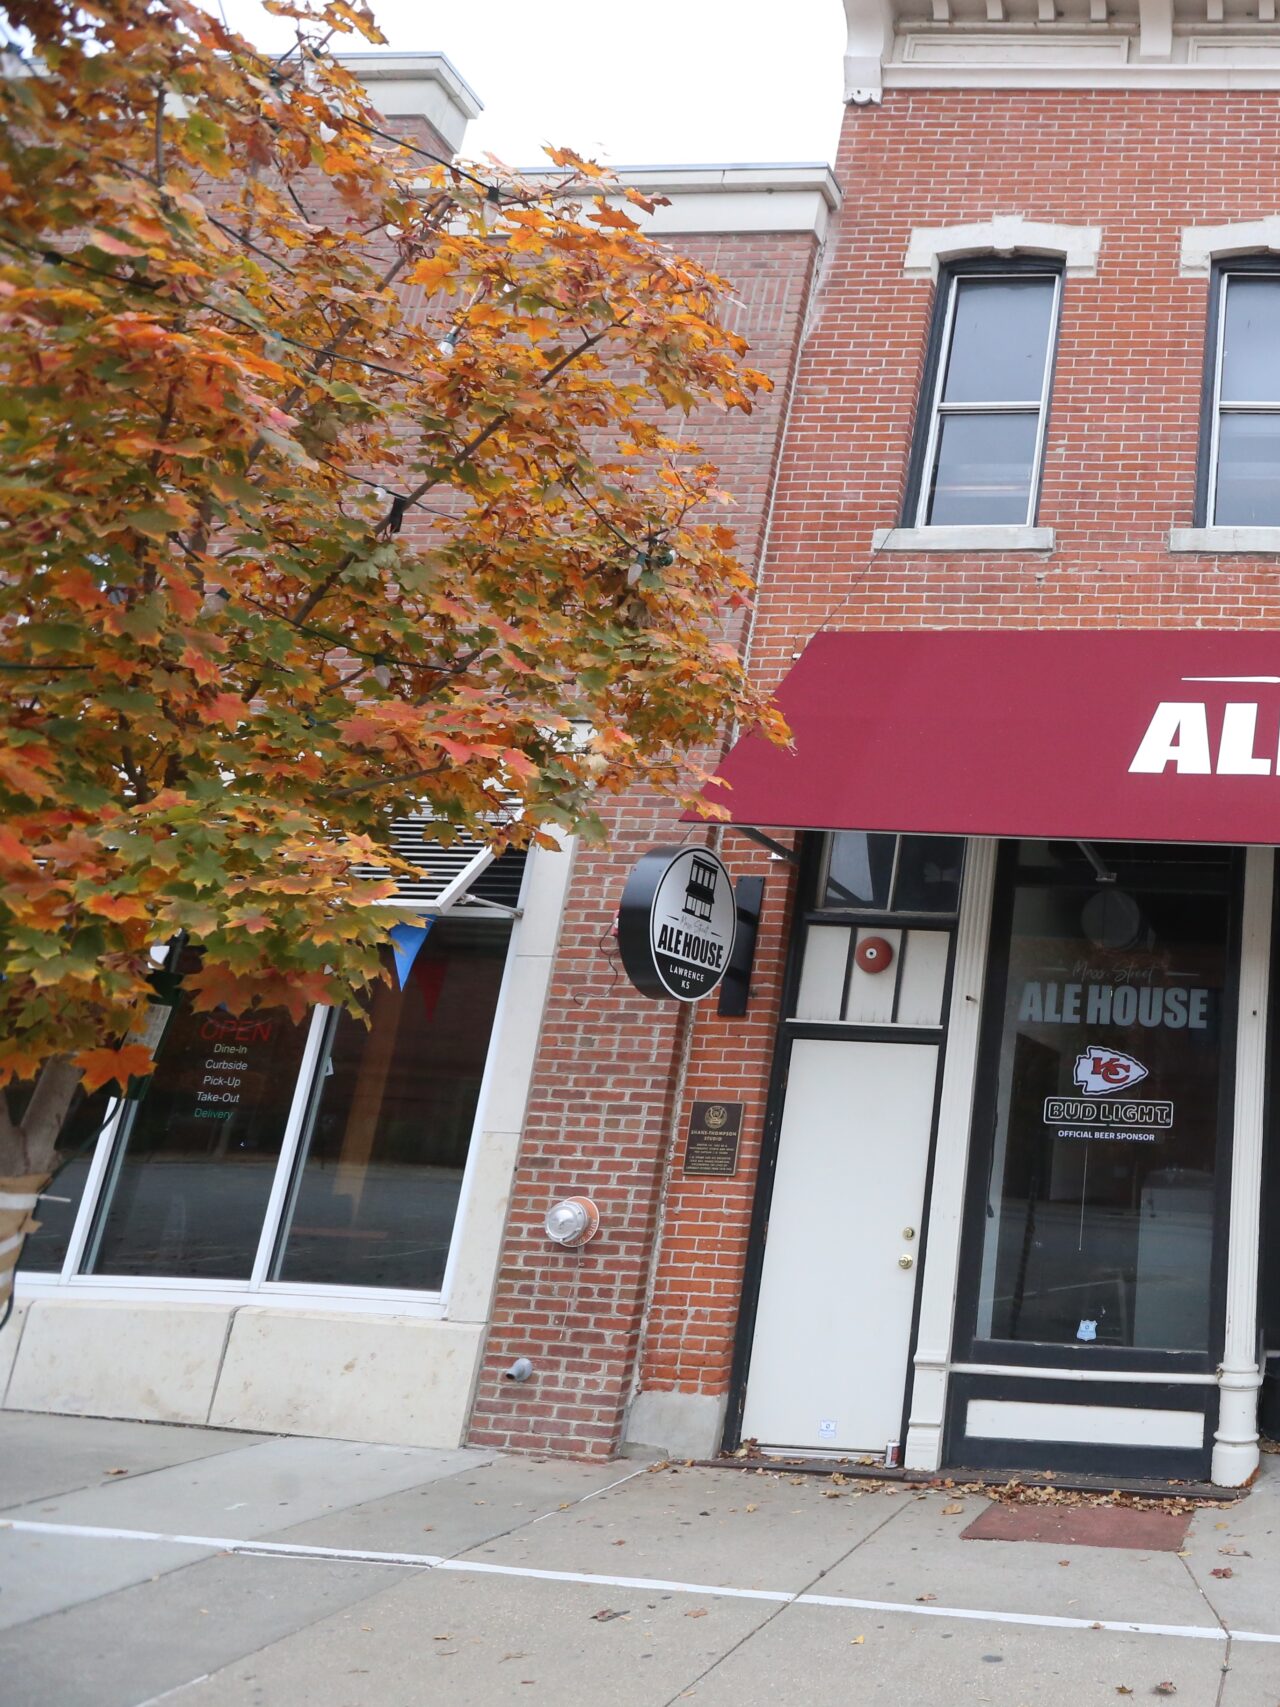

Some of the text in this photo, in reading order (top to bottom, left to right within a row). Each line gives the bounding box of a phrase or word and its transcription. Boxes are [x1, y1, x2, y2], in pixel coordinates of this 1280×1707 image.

[669, 964, 705, 983] LAWRENCE
[681, 980, 690, 990] KS
[198, 1019, 273, 1041] OPEN
[213, 1043, 248, 1054] Dine-In
[205, 1059, 248, 1070] Curbside
[203, 1075, 241, 1088] Pick-Up
[196, 1091, 240, 1103] Take-Out
[194, 1108, 233, 1121] Delivery
[1047, 1101, 1171, 1124] BUD LIGHT
[1057, 1129, 1155, 1142] OFFICIAL BEER SPONSOR
